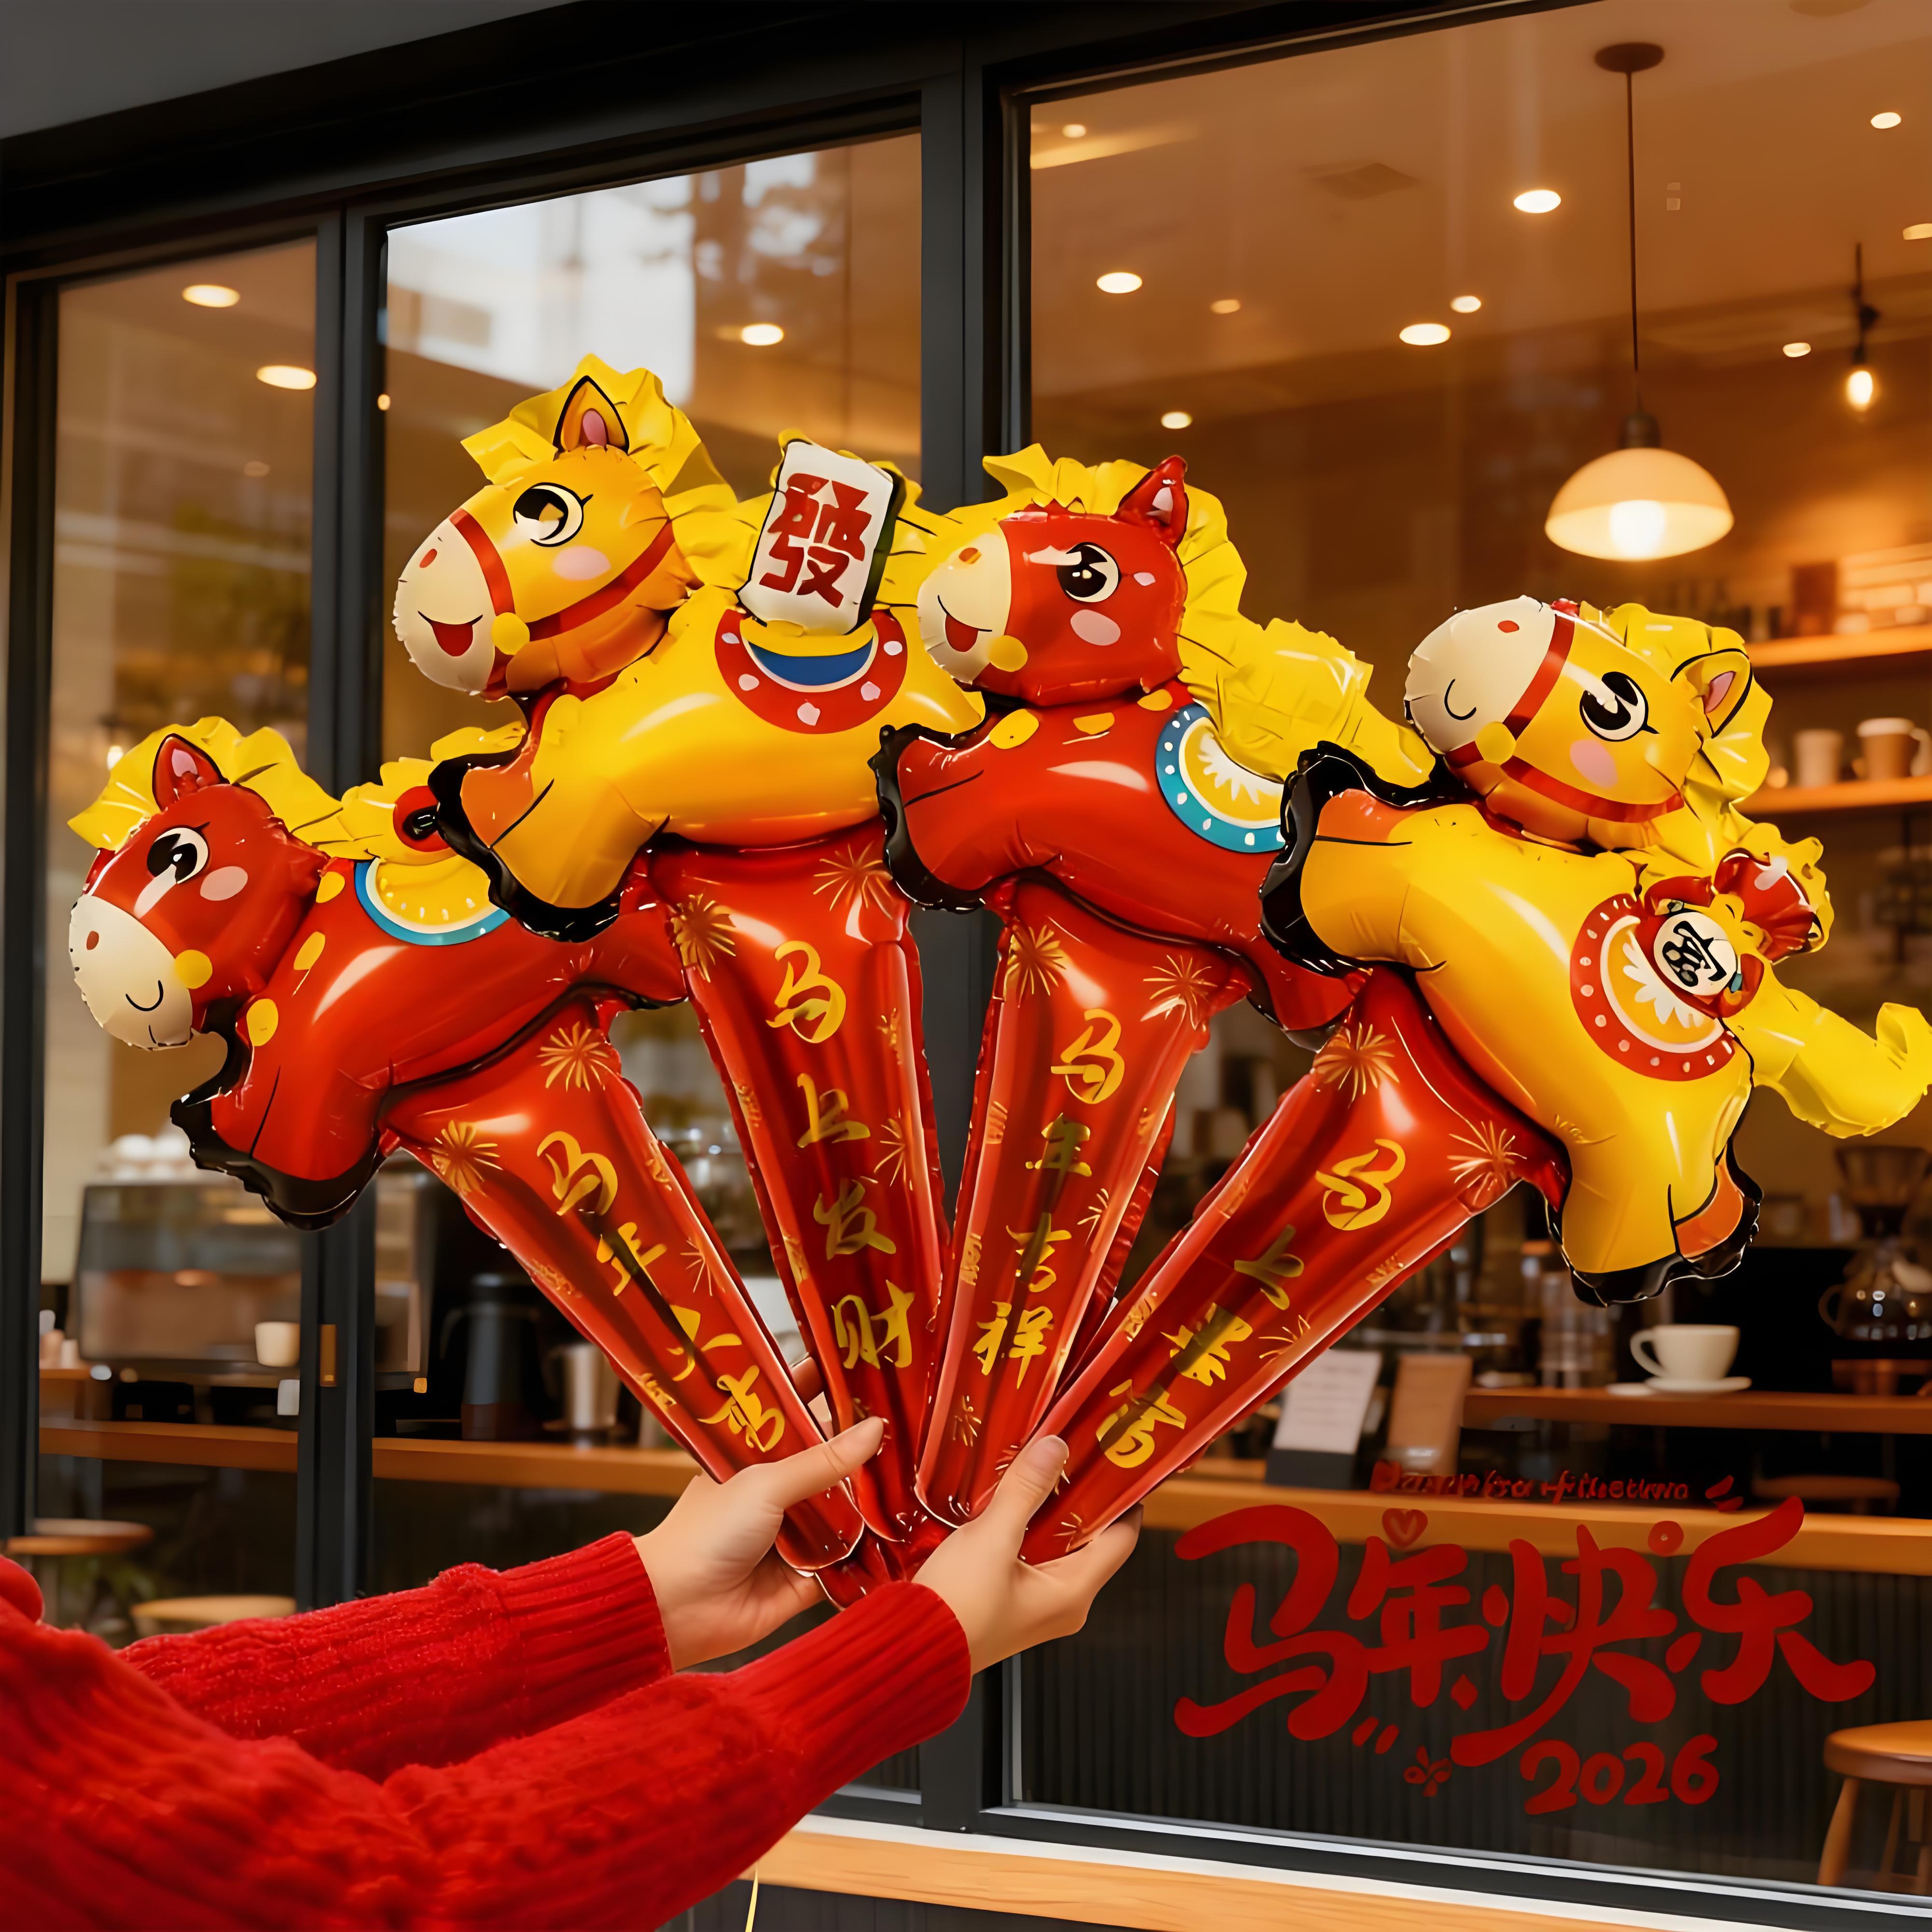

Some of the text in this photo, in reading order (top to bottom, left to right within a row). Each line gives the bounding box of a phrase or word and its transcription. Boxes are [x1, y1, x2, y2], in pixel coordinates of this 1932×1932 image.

[766, 940, 915, 1369] 马上发财
[972, 1009, 1125, 1389] 马年吉祥
[1174, 1495, 1876, 1766] 马年快乐
[1520, 1733, 1720, 1815] 2026
